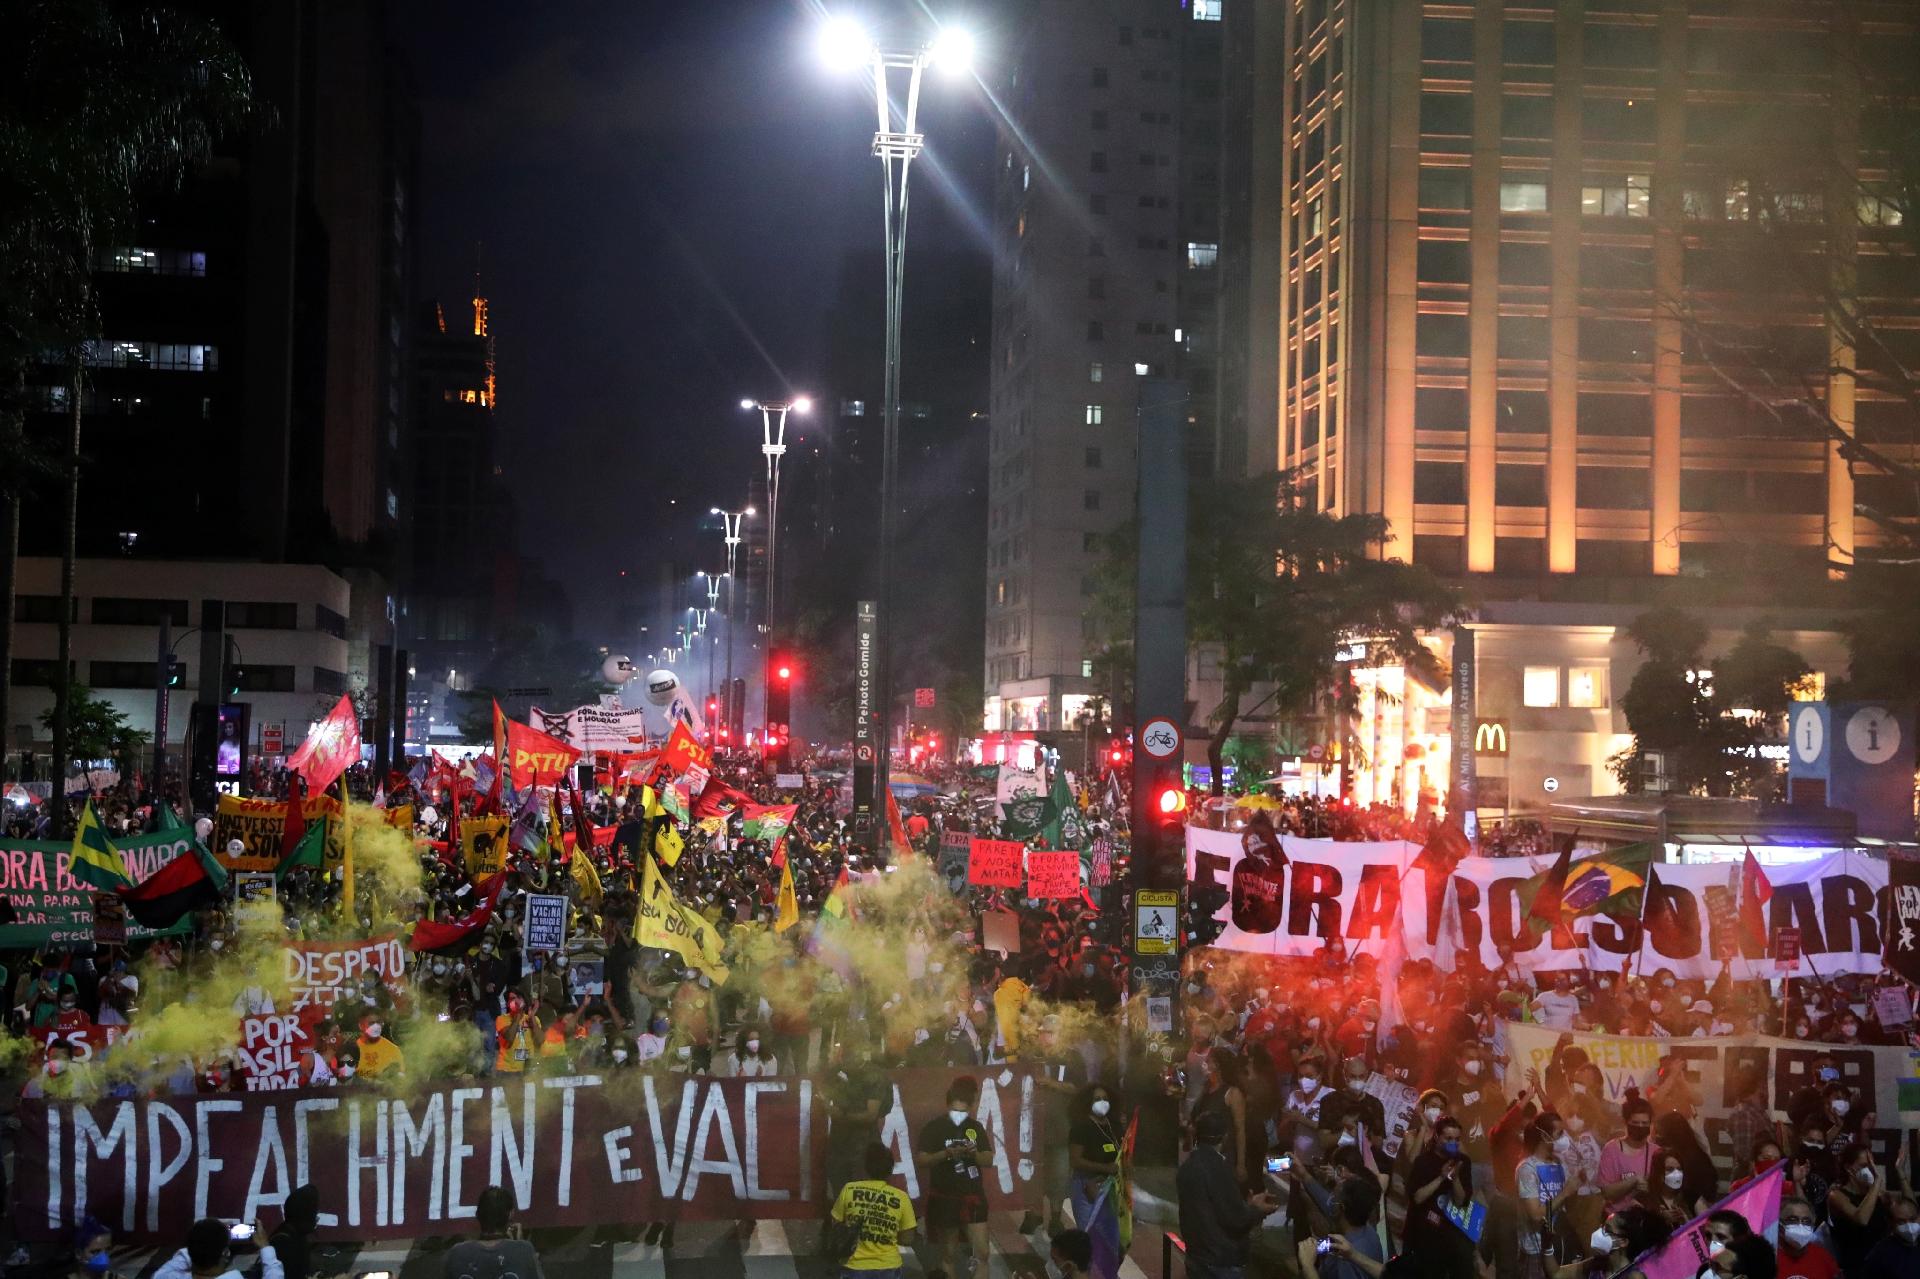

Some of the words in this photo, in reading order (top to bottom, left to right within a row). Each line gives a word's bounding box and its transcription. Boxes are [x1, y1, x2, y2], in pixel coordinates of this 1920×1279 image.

[859, 632, 871, 677] Gomide
[1458, 661, 1469, 710] Azevedo
[858, 679, 870, 725] Peixoto
[857, 728, 868, 738] R.
[1459, 713, 1469, 748] Rocha
[515, 749, 570, 775] PSTU
[1459, 753, 1470, 776] Min.
[1460, 778, 1470, 792] Al.
[979, 842, 1007, 855] PARE
[0, 850, 48, 892] ORA
[56, 839, 189, 892] BONARO
[980, 868, 1018, 880] MATAR
[44, 895, 80, 908] PARA
[1141, 894, 1173, 902] CICLISTA
[1195, 849, 1401, 940] FORA
[1426, 868, 1890, 960] BOONAR
[532, 906, 561, 917] VACINA
[285, 938, 405, 987] DESPEJO
[244, 1015, 308, 1048] POR
[238, 1046, 300, 1076] ASIL
[1529, 1040, 1662, 1070] PIFERIA
[47, 1074, 602, 1231] IMPEACHMENT
[603, 1125, 642, 1183] E
[643, 1075, 920, 1200] VACIA
[852, 1189, 901, 1209] RUAS
[854, 1202, 889, 1212] PORQUE
[867, 1210, 896, 1221] NOSSO
